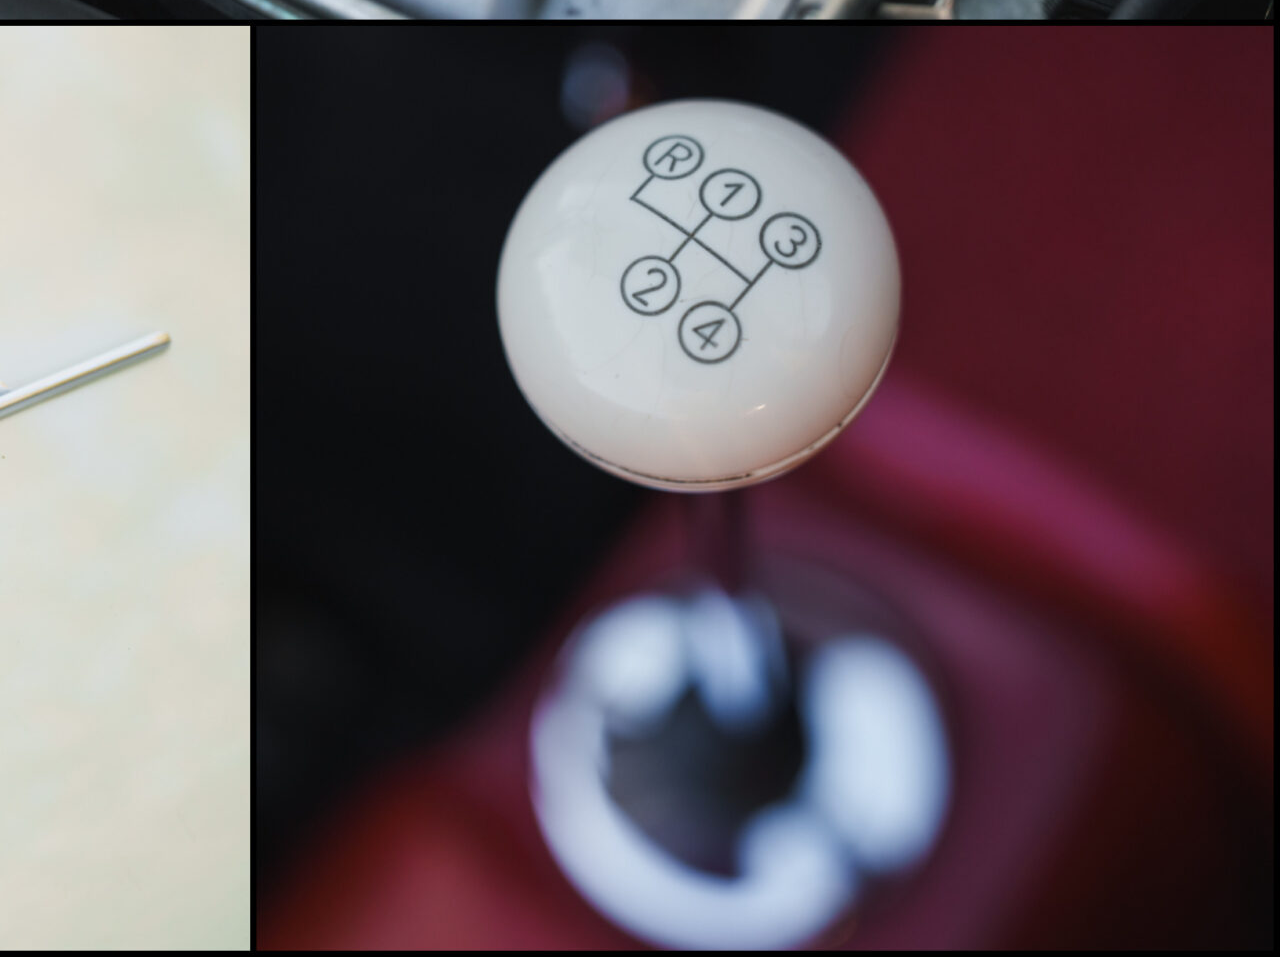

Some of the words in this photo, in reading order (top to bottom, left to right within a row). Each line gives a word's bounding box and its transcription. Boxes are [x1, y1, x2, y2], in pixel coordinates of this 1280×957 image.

[653, 142, 694, 173] R
[774, 224, 808, 259] 3
[631, 267, 668, 307] 2
[692, 318, 727, 351] 4
